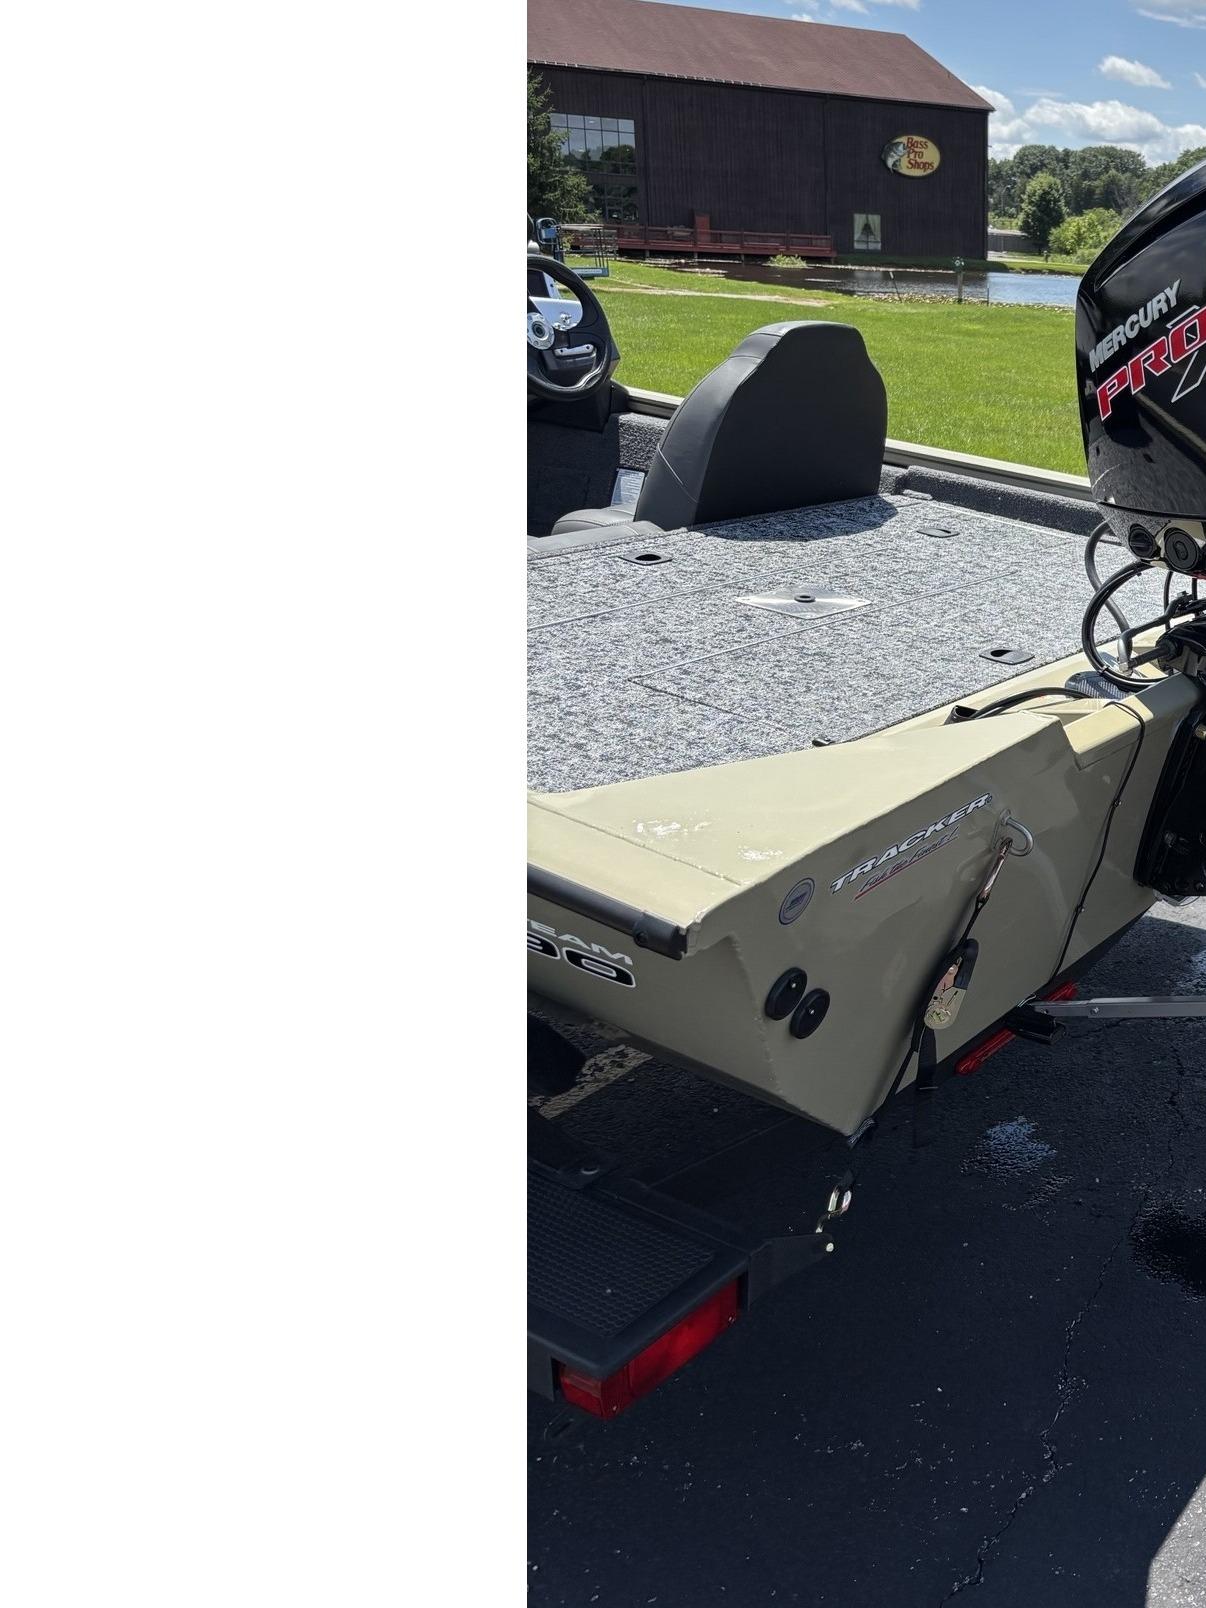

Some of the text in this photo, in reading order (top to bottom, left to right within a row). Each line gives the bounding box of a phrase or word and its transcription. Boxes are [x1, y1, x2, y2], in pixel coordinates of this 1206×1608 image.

[907, 137, 929, 150] Bass
[907, 149, 924, 159] Pro
[906, 158, 935, 172] Shops
[1089, 278, 1181, 373] MERCURY
[830, 793, 991, 894] TRACKER
[527, 918, 634, 965] EAM
